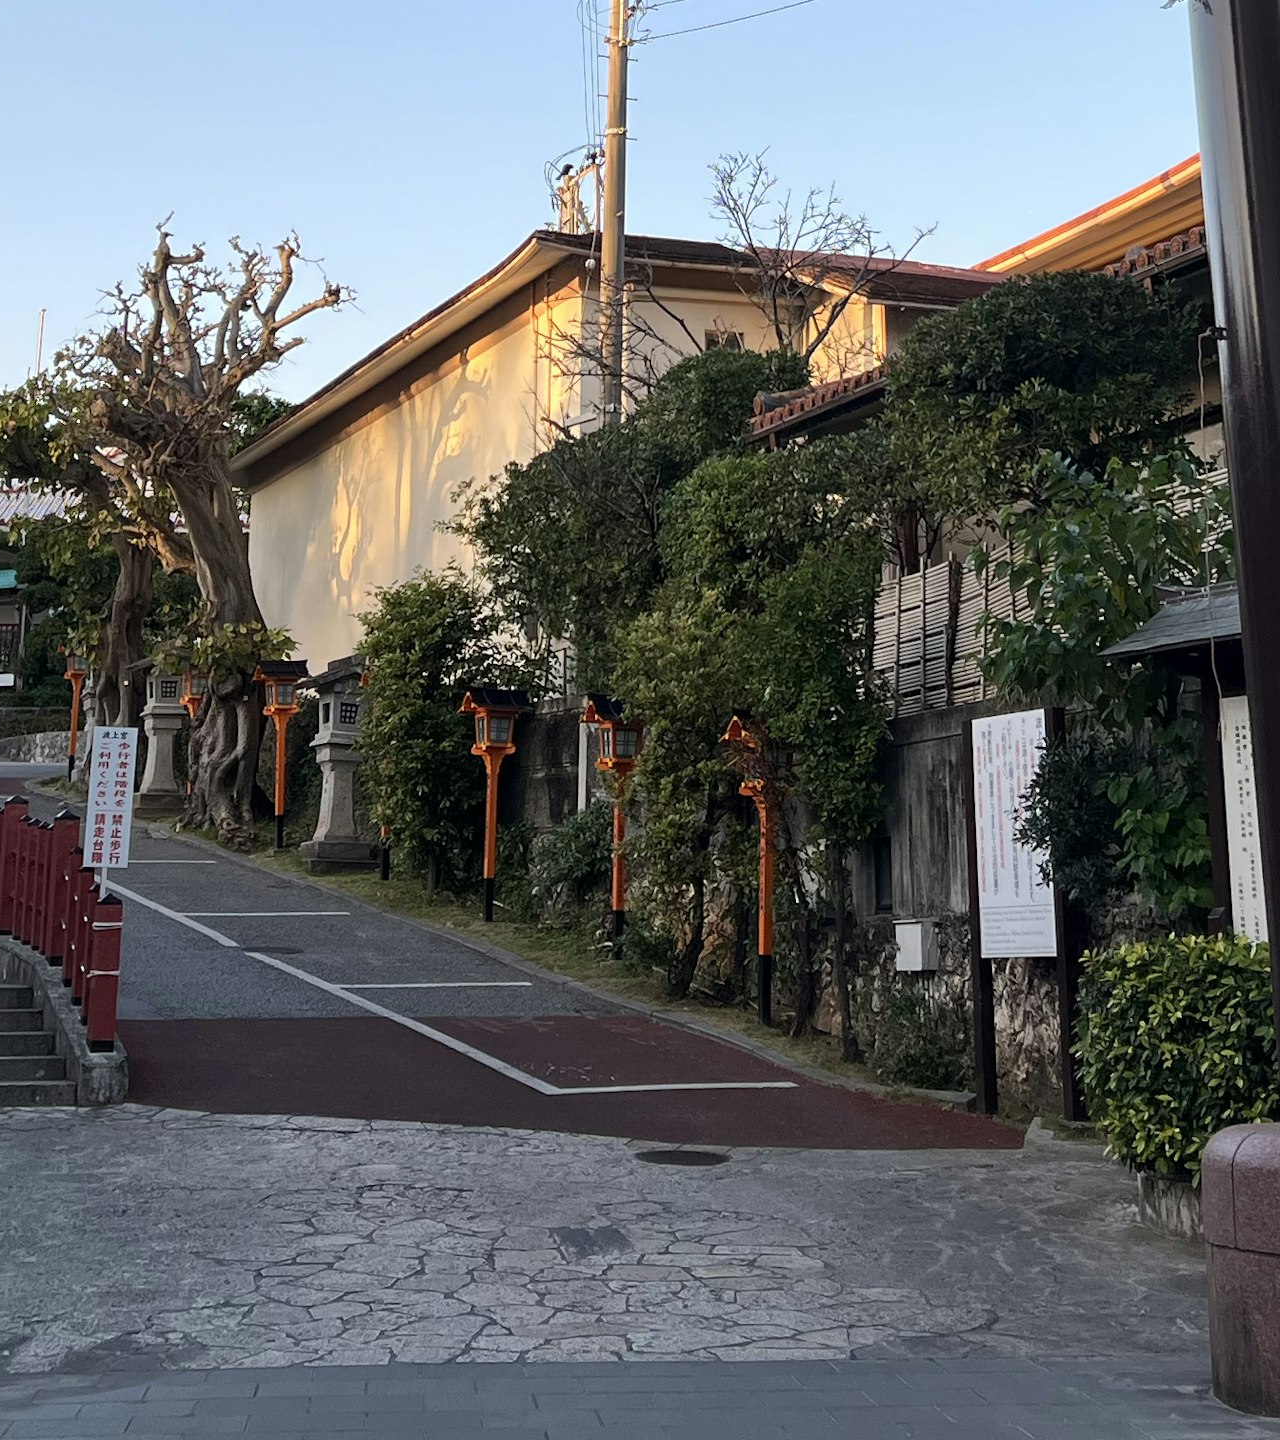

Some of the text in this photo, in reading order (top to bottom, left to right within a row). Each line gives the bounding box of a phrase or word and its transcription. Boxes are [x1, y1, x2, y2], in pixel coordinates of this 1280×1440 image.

[102, 731, 129, 740] 波上宮
[95, 741, 111, 807] ご利用ください
[91, 813, 106, 864] 請走台階
[108, 814, 123, 865] 禁止歩行
